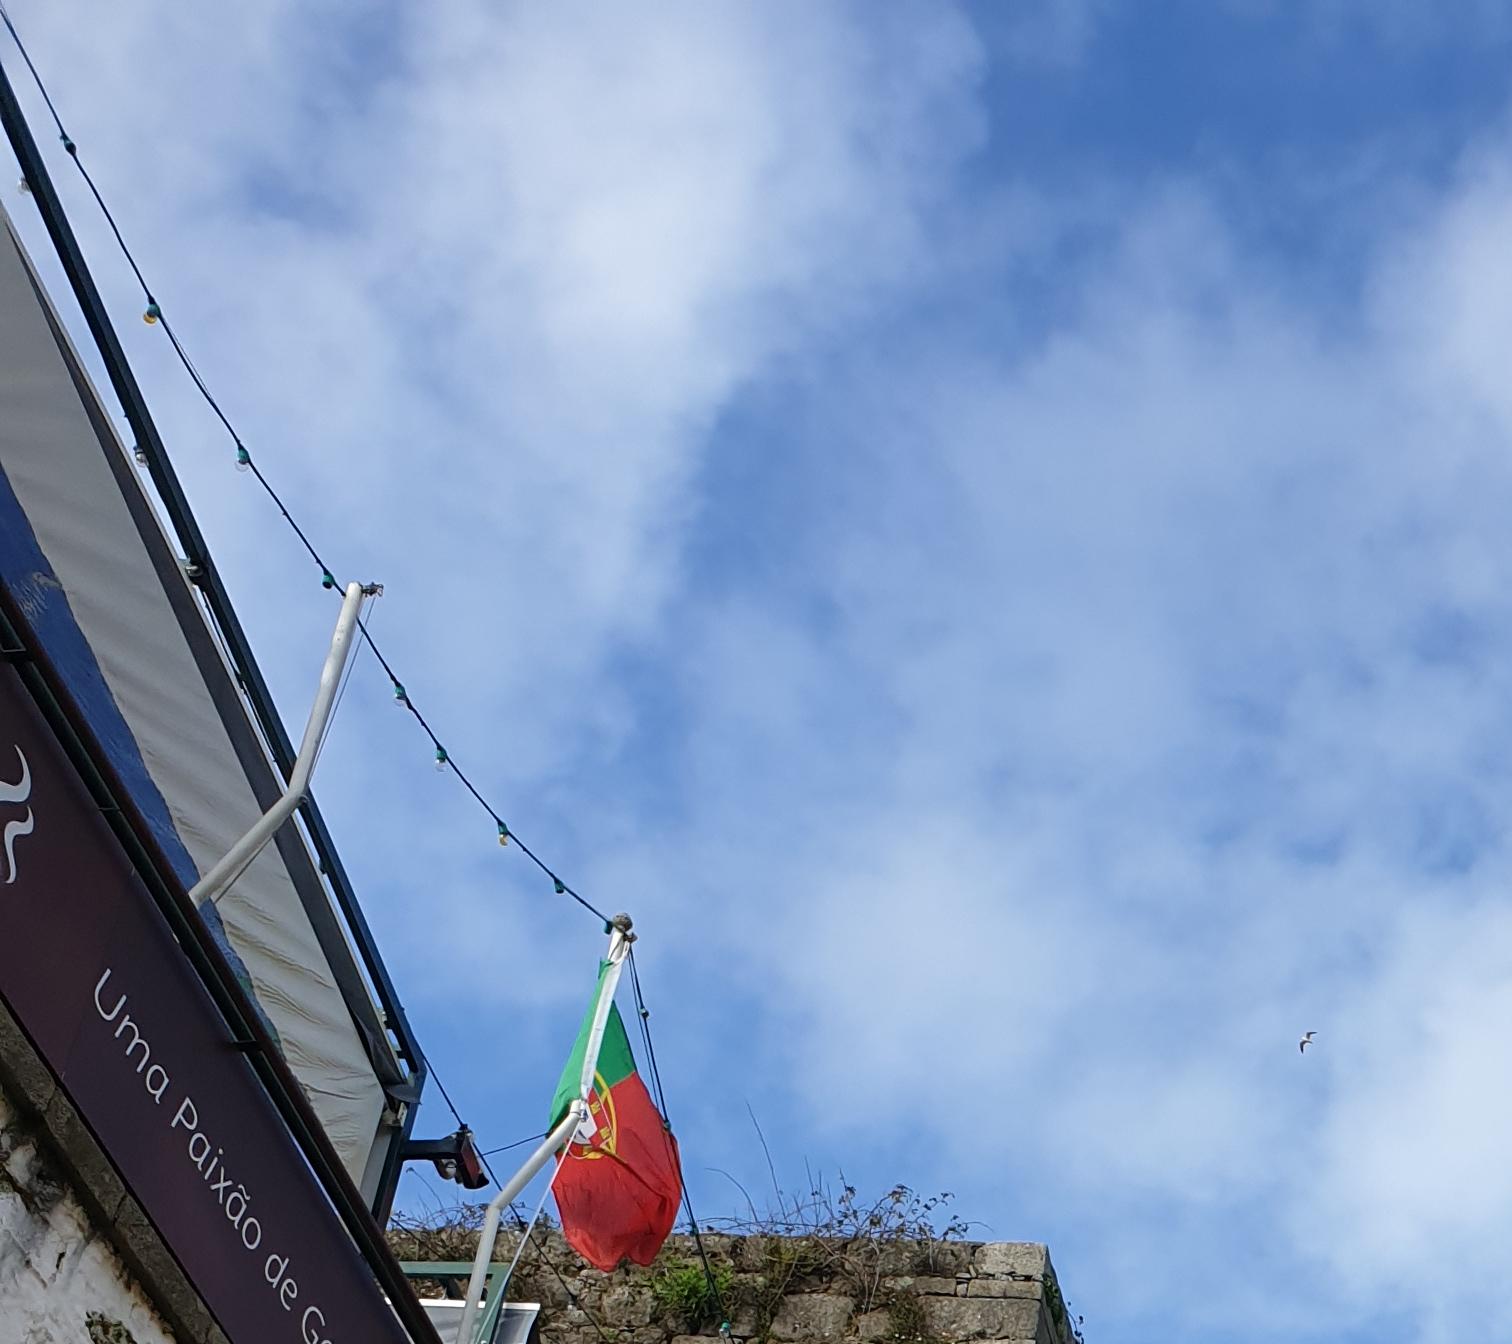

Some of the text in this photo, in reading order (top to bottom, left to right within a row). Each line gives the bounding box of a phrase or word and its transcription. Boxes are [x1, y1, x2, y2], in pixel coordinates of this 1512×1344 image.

[94, 967, 173, 1106] Uma
[170, 1095, 263, 1251] Paixão
[263, 1253, 299, 1312] de
